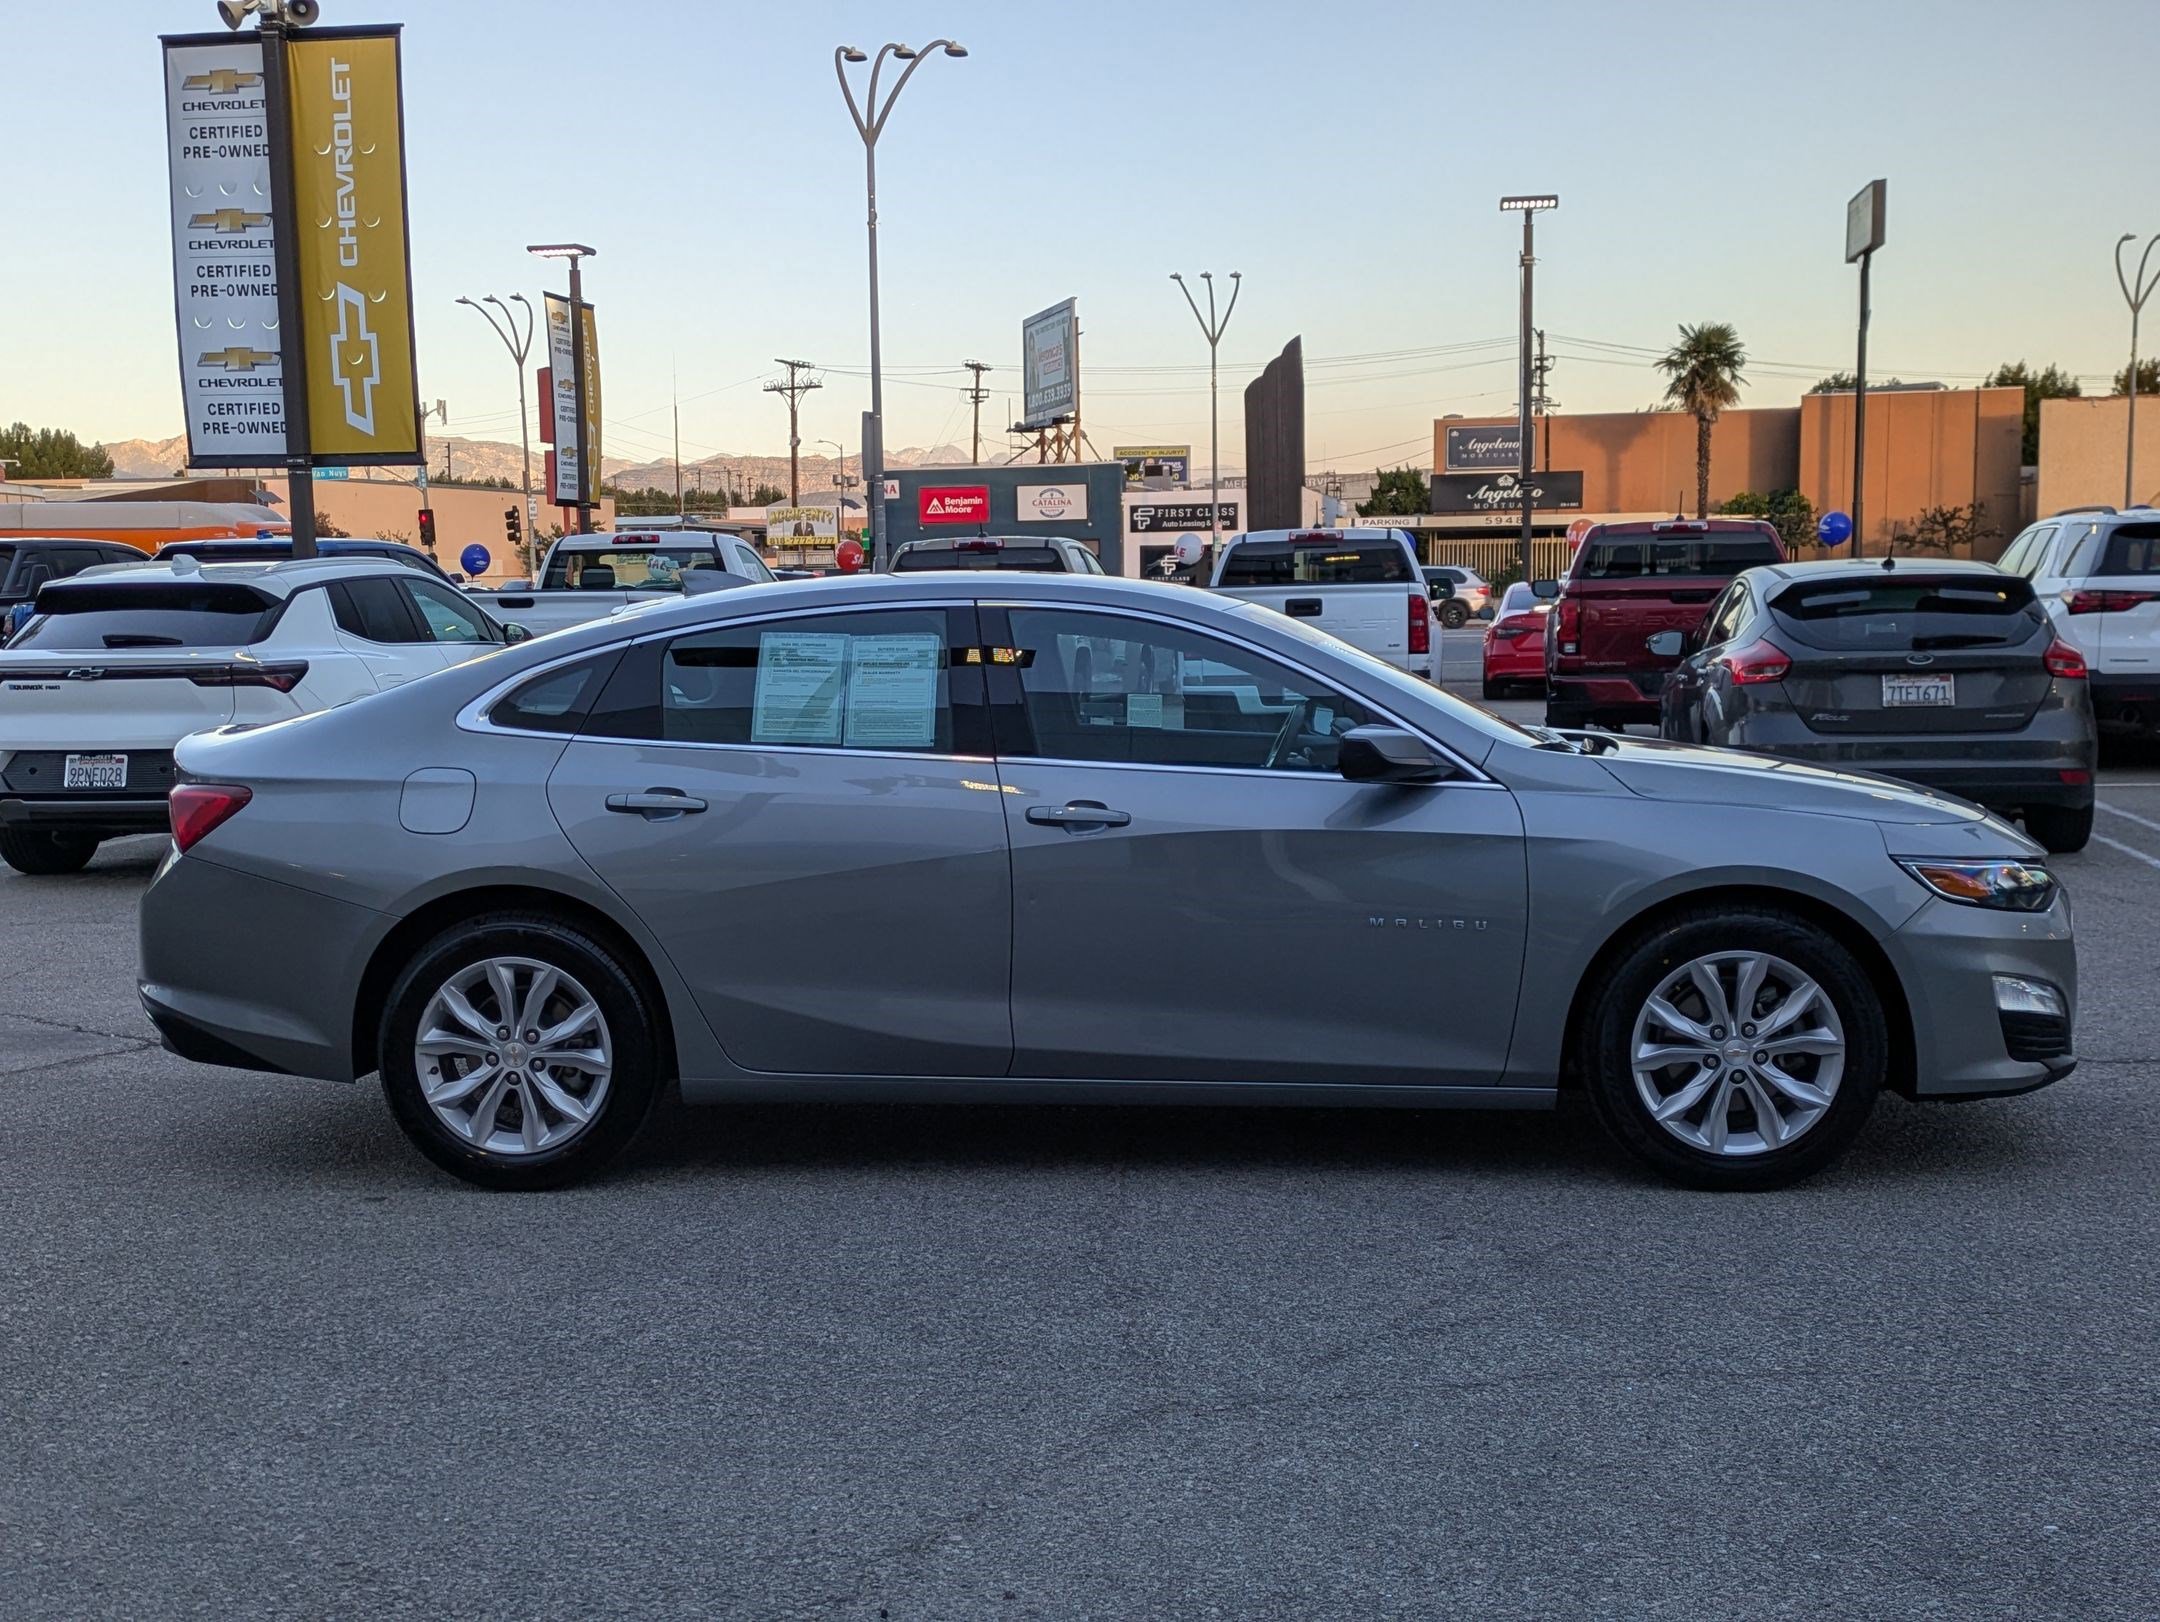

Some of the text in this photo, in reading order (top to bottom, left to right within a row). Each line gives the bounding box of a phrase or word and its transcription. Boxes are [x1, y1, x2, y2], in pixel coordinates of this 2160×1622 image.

[182, 99, 266, 112] CHEVROLET
[189, 124, 263, 139] CERTIFIED
[183, 144, 270, 159] PRE-OWNED
[331, 57, 358, 267] CHEVROLET
[188, 239, 274, 250] CHEVROLET
[196, 264, 271, 278] CERTIFIED
[191, 283, 279, 298] PRE-OWNED
[199, 378, 283, 388] CHEVROLET
[207, 402, 280, 416] CERTIFIED
[203, 421, 286, 435] PRE-OWNED
[1459, 438, 1520, 453] Angeleno
[1467, 484, 1544, 503] Angeleo
[944, 496, 983, 506] Benjamin
[1032, 499, 1073, 507] CATALINA
[944, 505, 973, 514] Moore
[1157, 507, 1235, 518] FIRST CLSS
[1162, 520, 1178, 528] Auto
[1179, 519, 1205, 528] Leasing
[1362, 518, 1410, 526] PARKING
[1369, 917, 1488, 930] MALIBU
